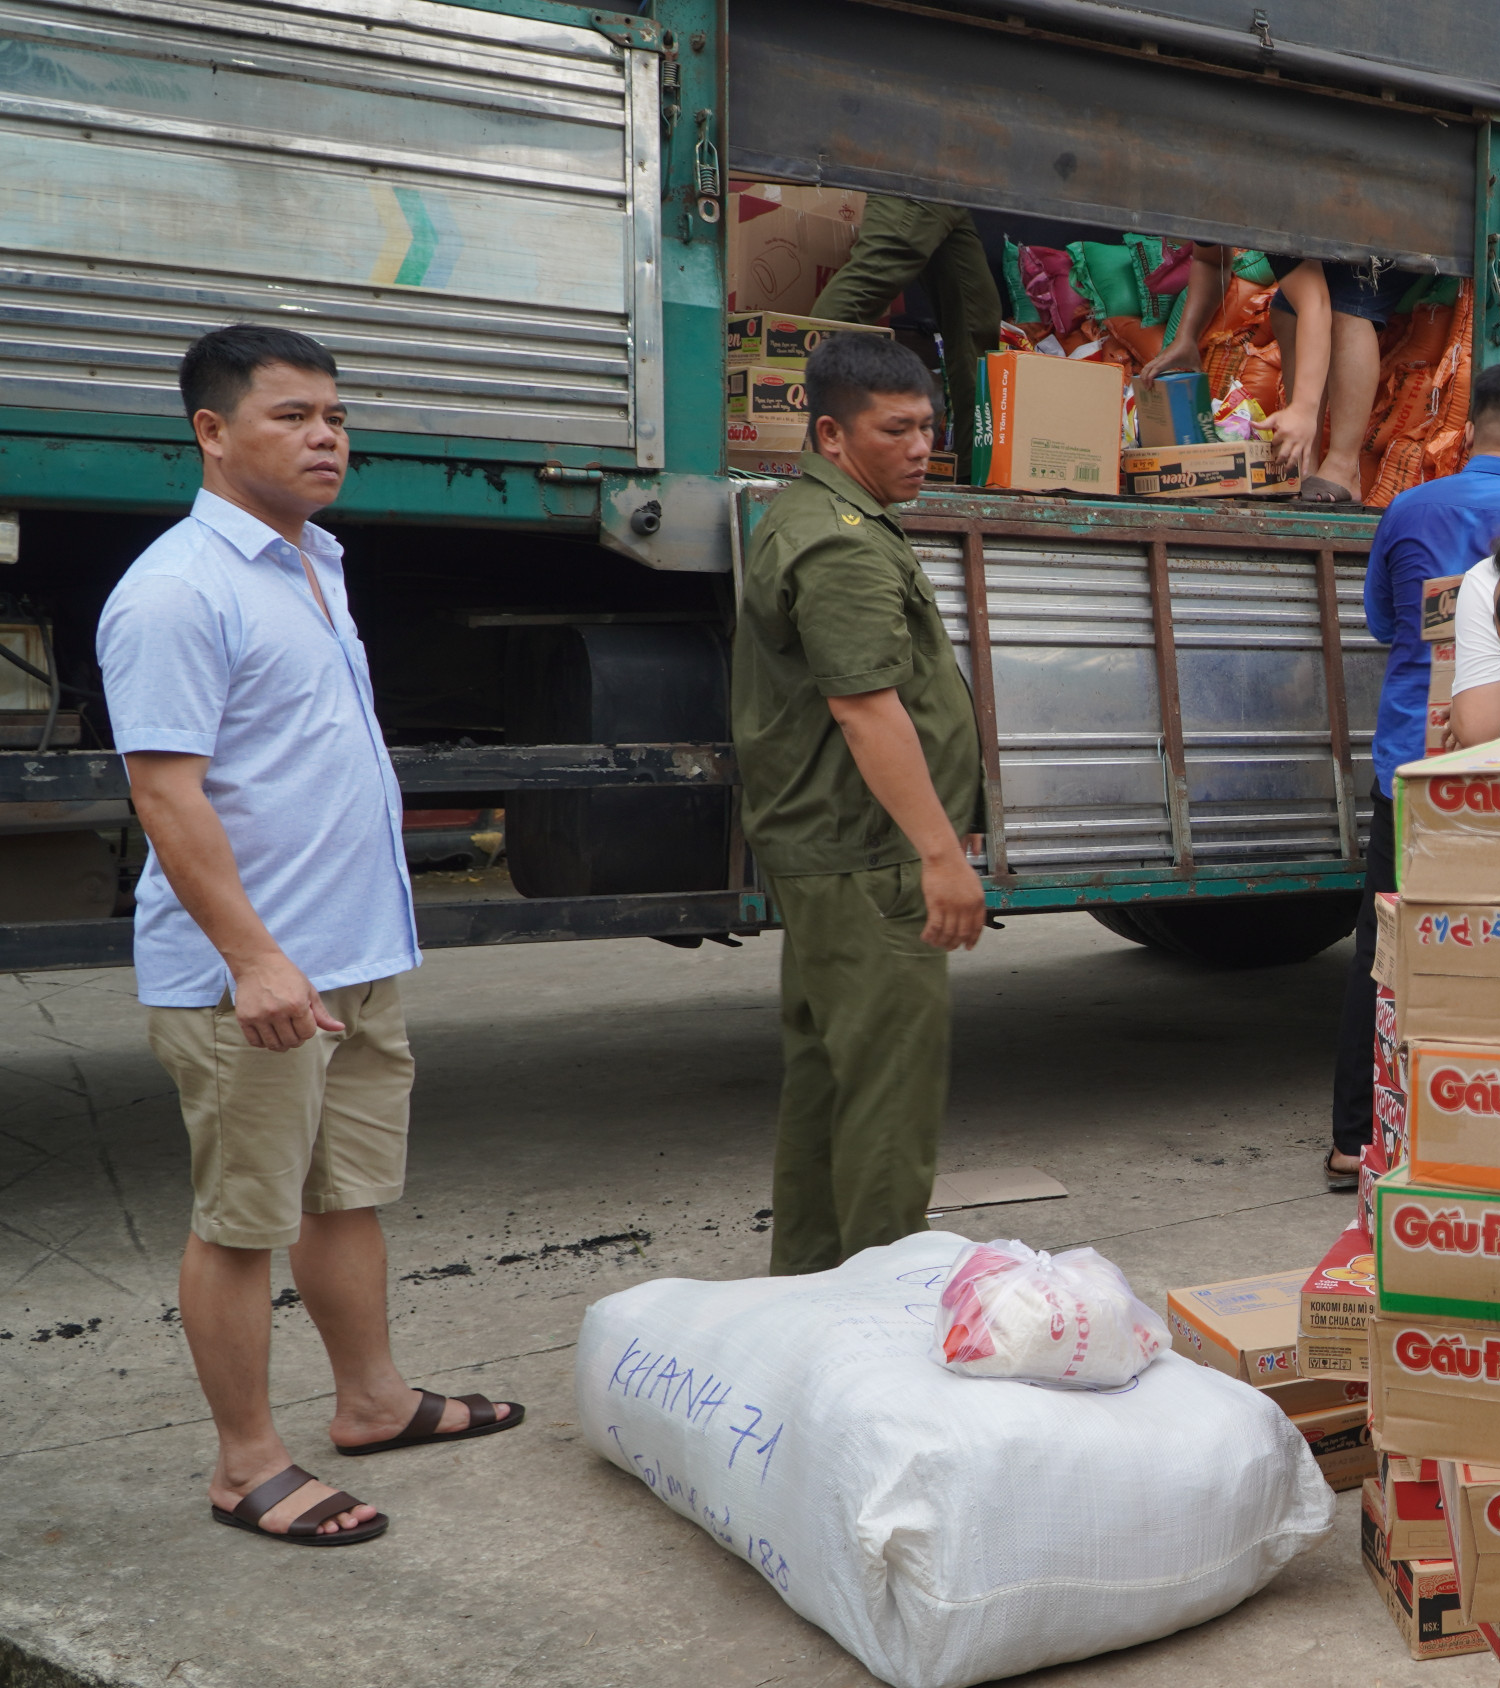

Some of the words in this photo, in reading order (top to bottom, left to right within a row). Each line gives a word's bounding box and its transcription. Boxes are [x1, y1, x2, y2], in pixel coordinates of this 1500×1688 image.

[1418, 915, 1474, 946] Phở
[1310, 1302, 1340, 1312] KOKOMI
[1342, 1303, 1355, 1315] ĐẠI
[1358, 1302, 1367, 1313] MÌ
[1369, 1305, 1375, 1314] 9
[1310, 1313, 1326, 1325] TÔM
[1329, 1316, 1349, 1326] CHUA
[1352, 1317, 1366, 1327] CAY
[608, 1338, 732, 1435] KHANH
[728, 1404, 784, 1486] 71
